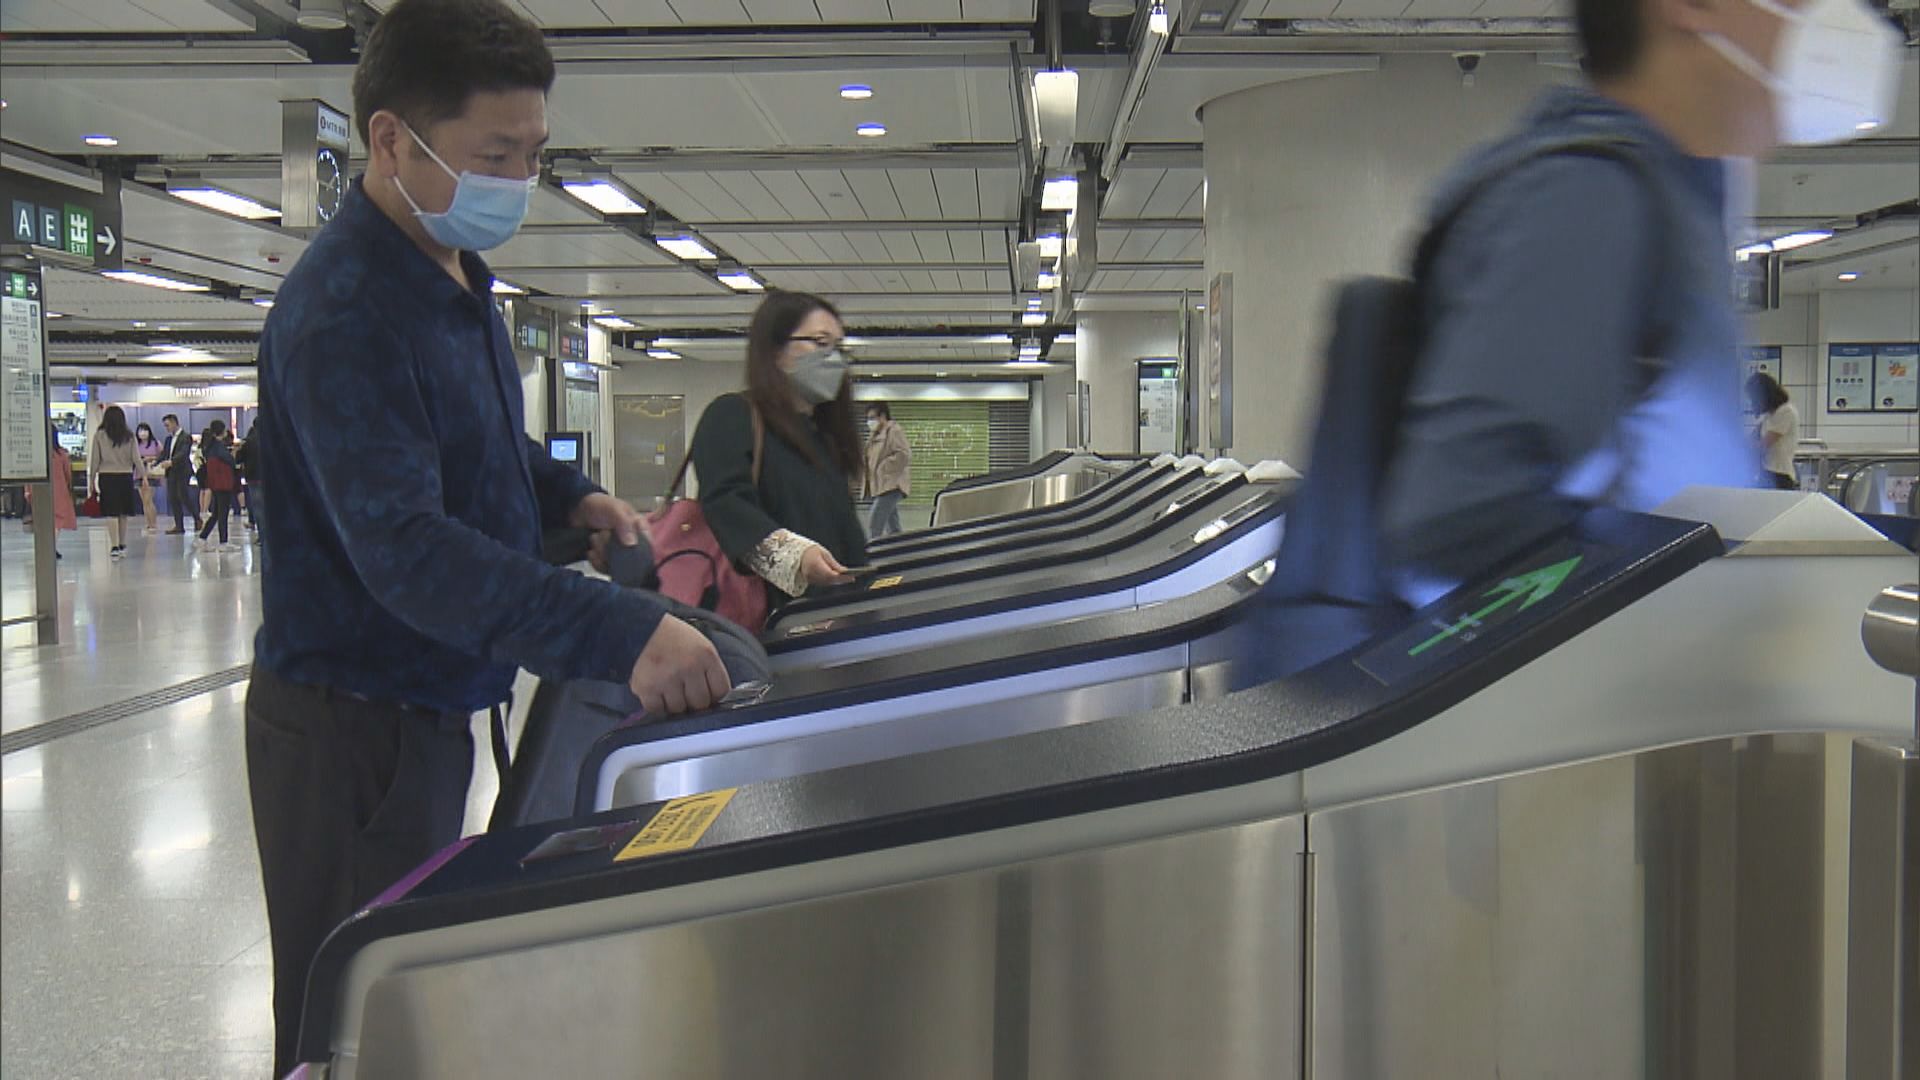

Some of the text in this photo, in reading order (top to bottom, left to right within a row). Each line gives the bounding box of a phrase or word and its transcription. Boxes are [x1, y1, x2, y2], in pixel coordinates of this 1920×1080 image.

[18, 208, 56, 241] A E
[70, 213, 88, 243] 出
[71, 242, 88, 256] EXIT
